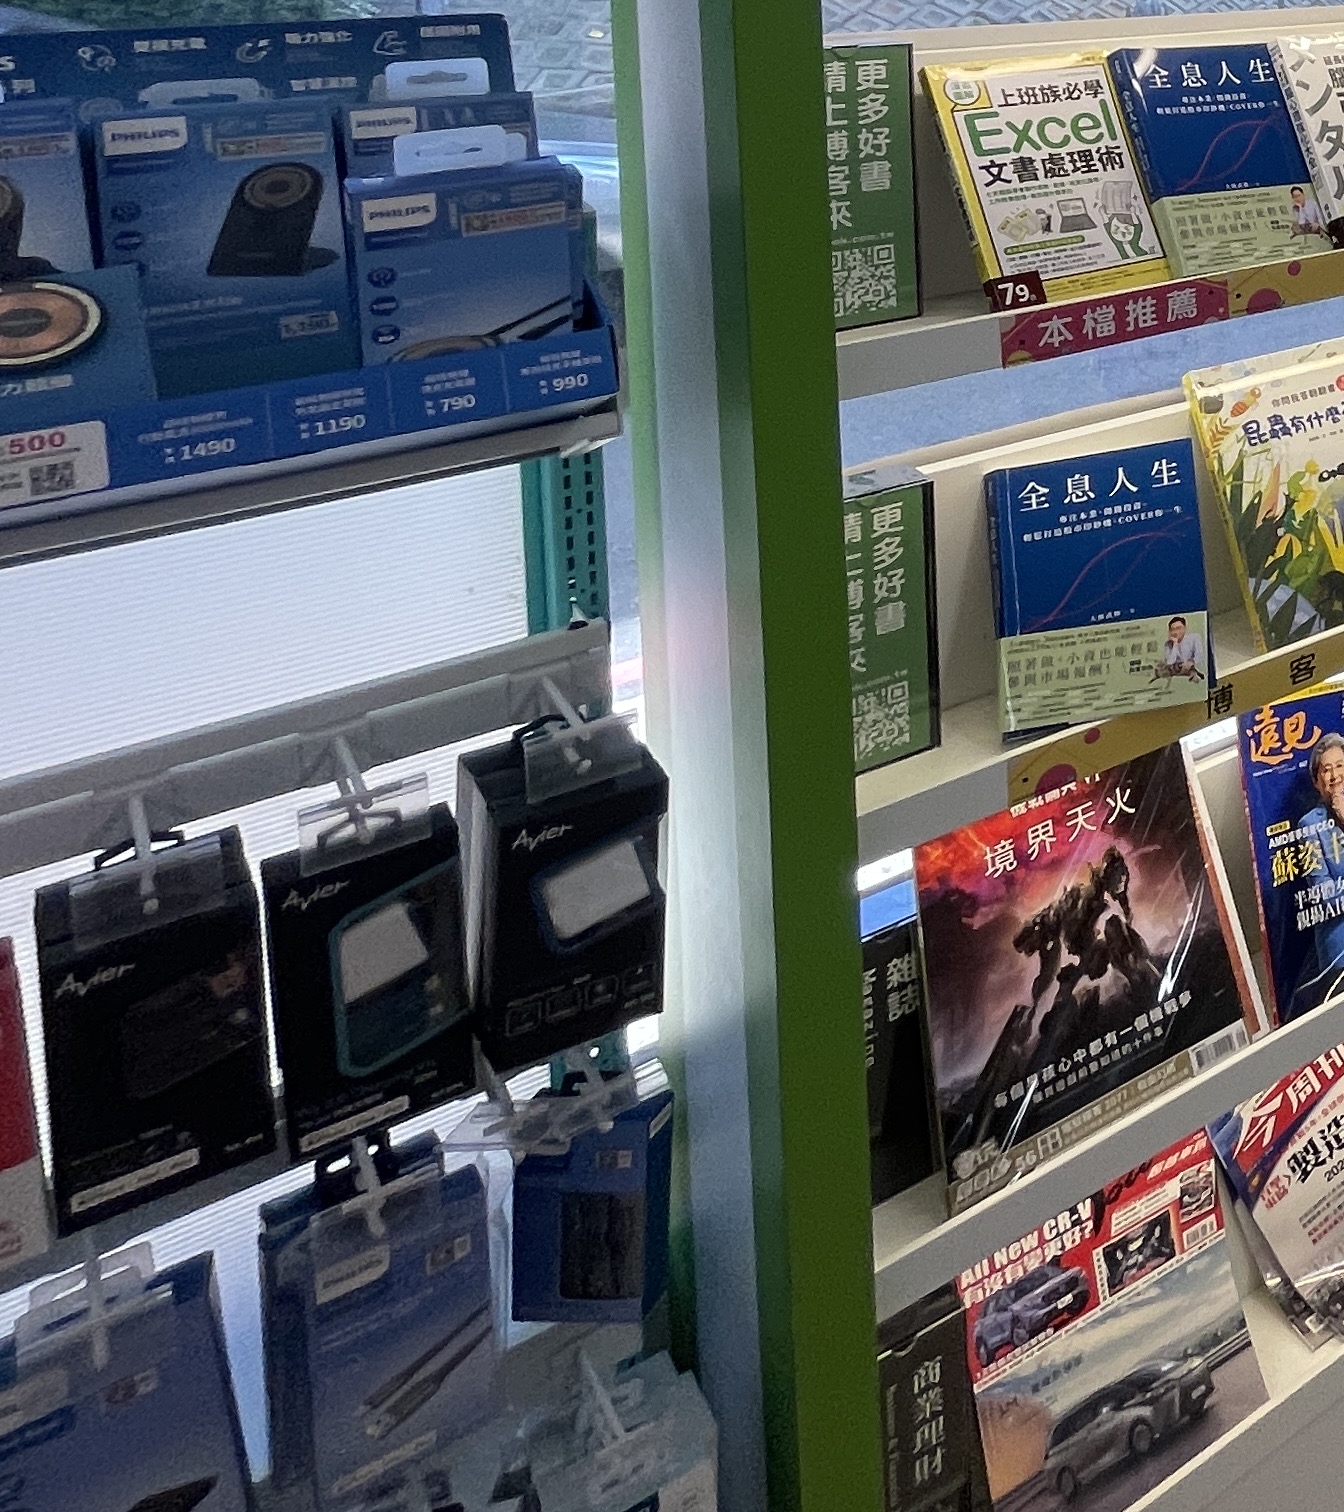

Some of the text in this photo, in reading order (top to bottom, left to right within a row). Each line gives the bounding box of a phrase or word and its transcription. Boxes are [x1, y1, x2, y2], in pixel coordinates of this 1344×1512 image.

[997, 79, 1104, 108] 上班族必學
[1144, 58, 1275, 89] 全息人生
[856, 59, 891, 192] 更多好書
[964, 99, 1118, 157] Excel
[978, 145, 1124, 188] 文書處理術
[1038, 287, 1199, 348] 本檔推薦
[552, 373, 589, 392] 990
[439, 394, 476, 413] 790
[315, 414, 367, 436] 1190
[180, 438, 237, 462] 1490
[1017, 459, 1182, 513] 全息人生
[870, 502, 907, 636] 更多好書
[1246, 704, 1323, 765] 遠見
[511, 820, 574, 853] Avier
[984, 783, 1136, 880] 境界天火
[281, 879, 350, 911] Avier
[55, 962, 136, 999] Avier
[959, 1260, 992, 1290] All
[993, 1226, 1043, 1271] New
[1041, 1197, 1093, 1240] CR-V
